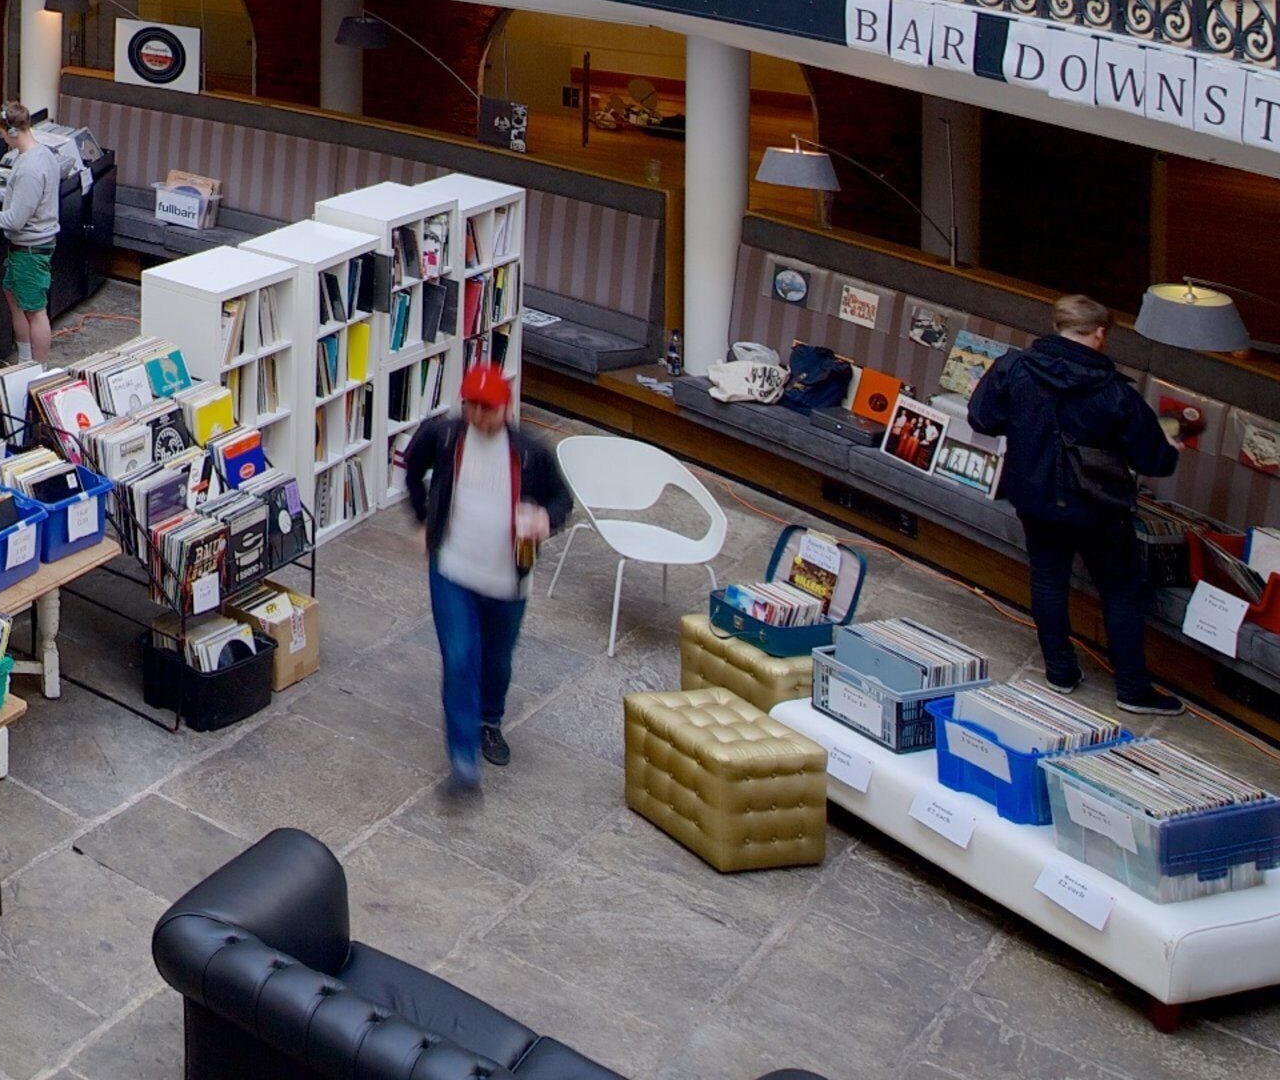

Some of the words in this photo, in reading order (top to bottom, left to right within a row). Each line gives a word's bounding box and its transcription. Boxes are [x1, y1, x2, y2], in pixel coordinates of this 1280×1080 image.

[855, 7, 967, 65] BAR
[1057, 879, 1068, 889] £2
[1068, 887, 1085, 899] each
